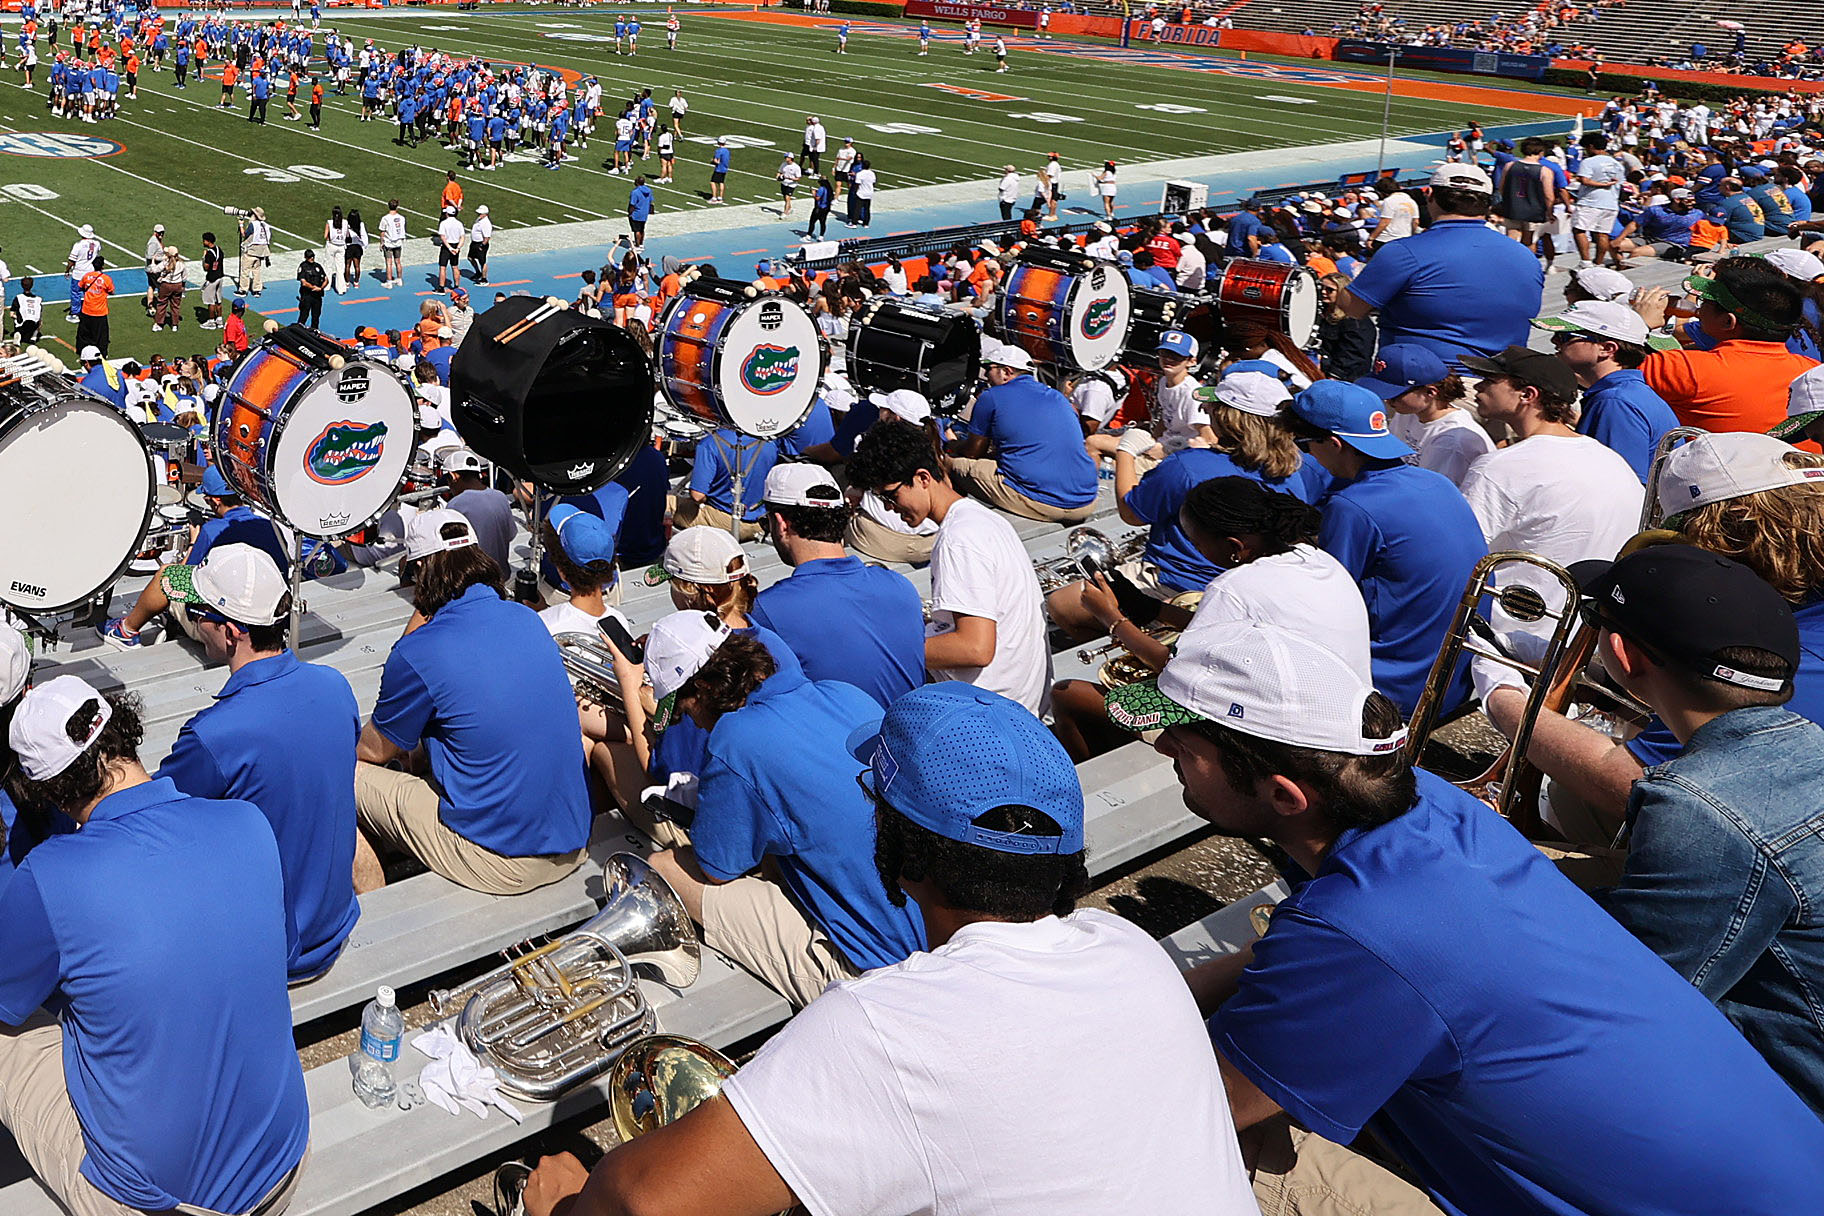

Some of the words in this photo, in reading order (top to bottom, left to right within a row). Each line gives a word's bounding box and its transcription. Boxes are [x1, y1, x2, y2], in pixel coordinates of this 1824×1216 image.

[934, 5, 969, 18] WELLS
[971, 8, 1007, 21] FARGO
[242, 164, 346, 183] 30
[761, 313, 782, 322] MAPEX
[339, 381, 367, 392] MAPEX
[322, 518, 346, 527] REMO
[10, 580, 47, 598] EVANS
[1740, 674, 1776, 688] Yankees
[1108, 701, 1135, 728] GATOR
[1133, 711, 1161, 727] BAND
